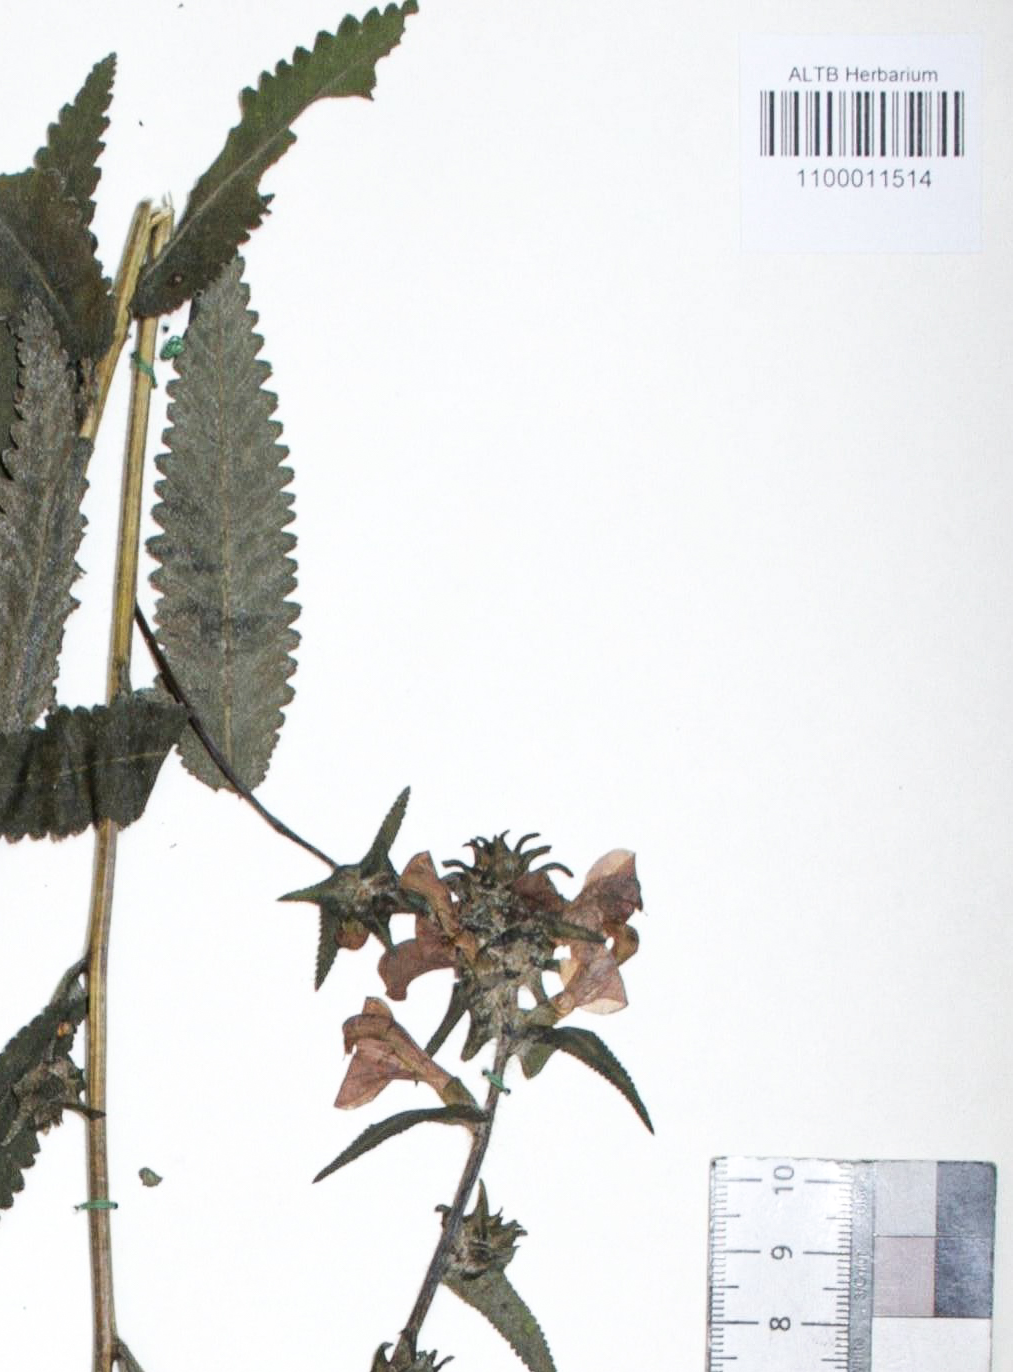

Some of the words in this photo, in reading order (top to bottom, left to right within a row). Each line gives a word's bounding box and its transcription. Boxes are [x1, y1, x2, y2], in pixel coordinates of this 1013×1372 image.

[788, 66, 838, 82] ALTB
[846, 66, 938, 82] Herbarium
[797, 168, 932, 188] 1100011514
[773, 1165, 795, 1195] 10
[771, 1245, 793, 1260] 9
[770, 1316, 791, 1331] 8
